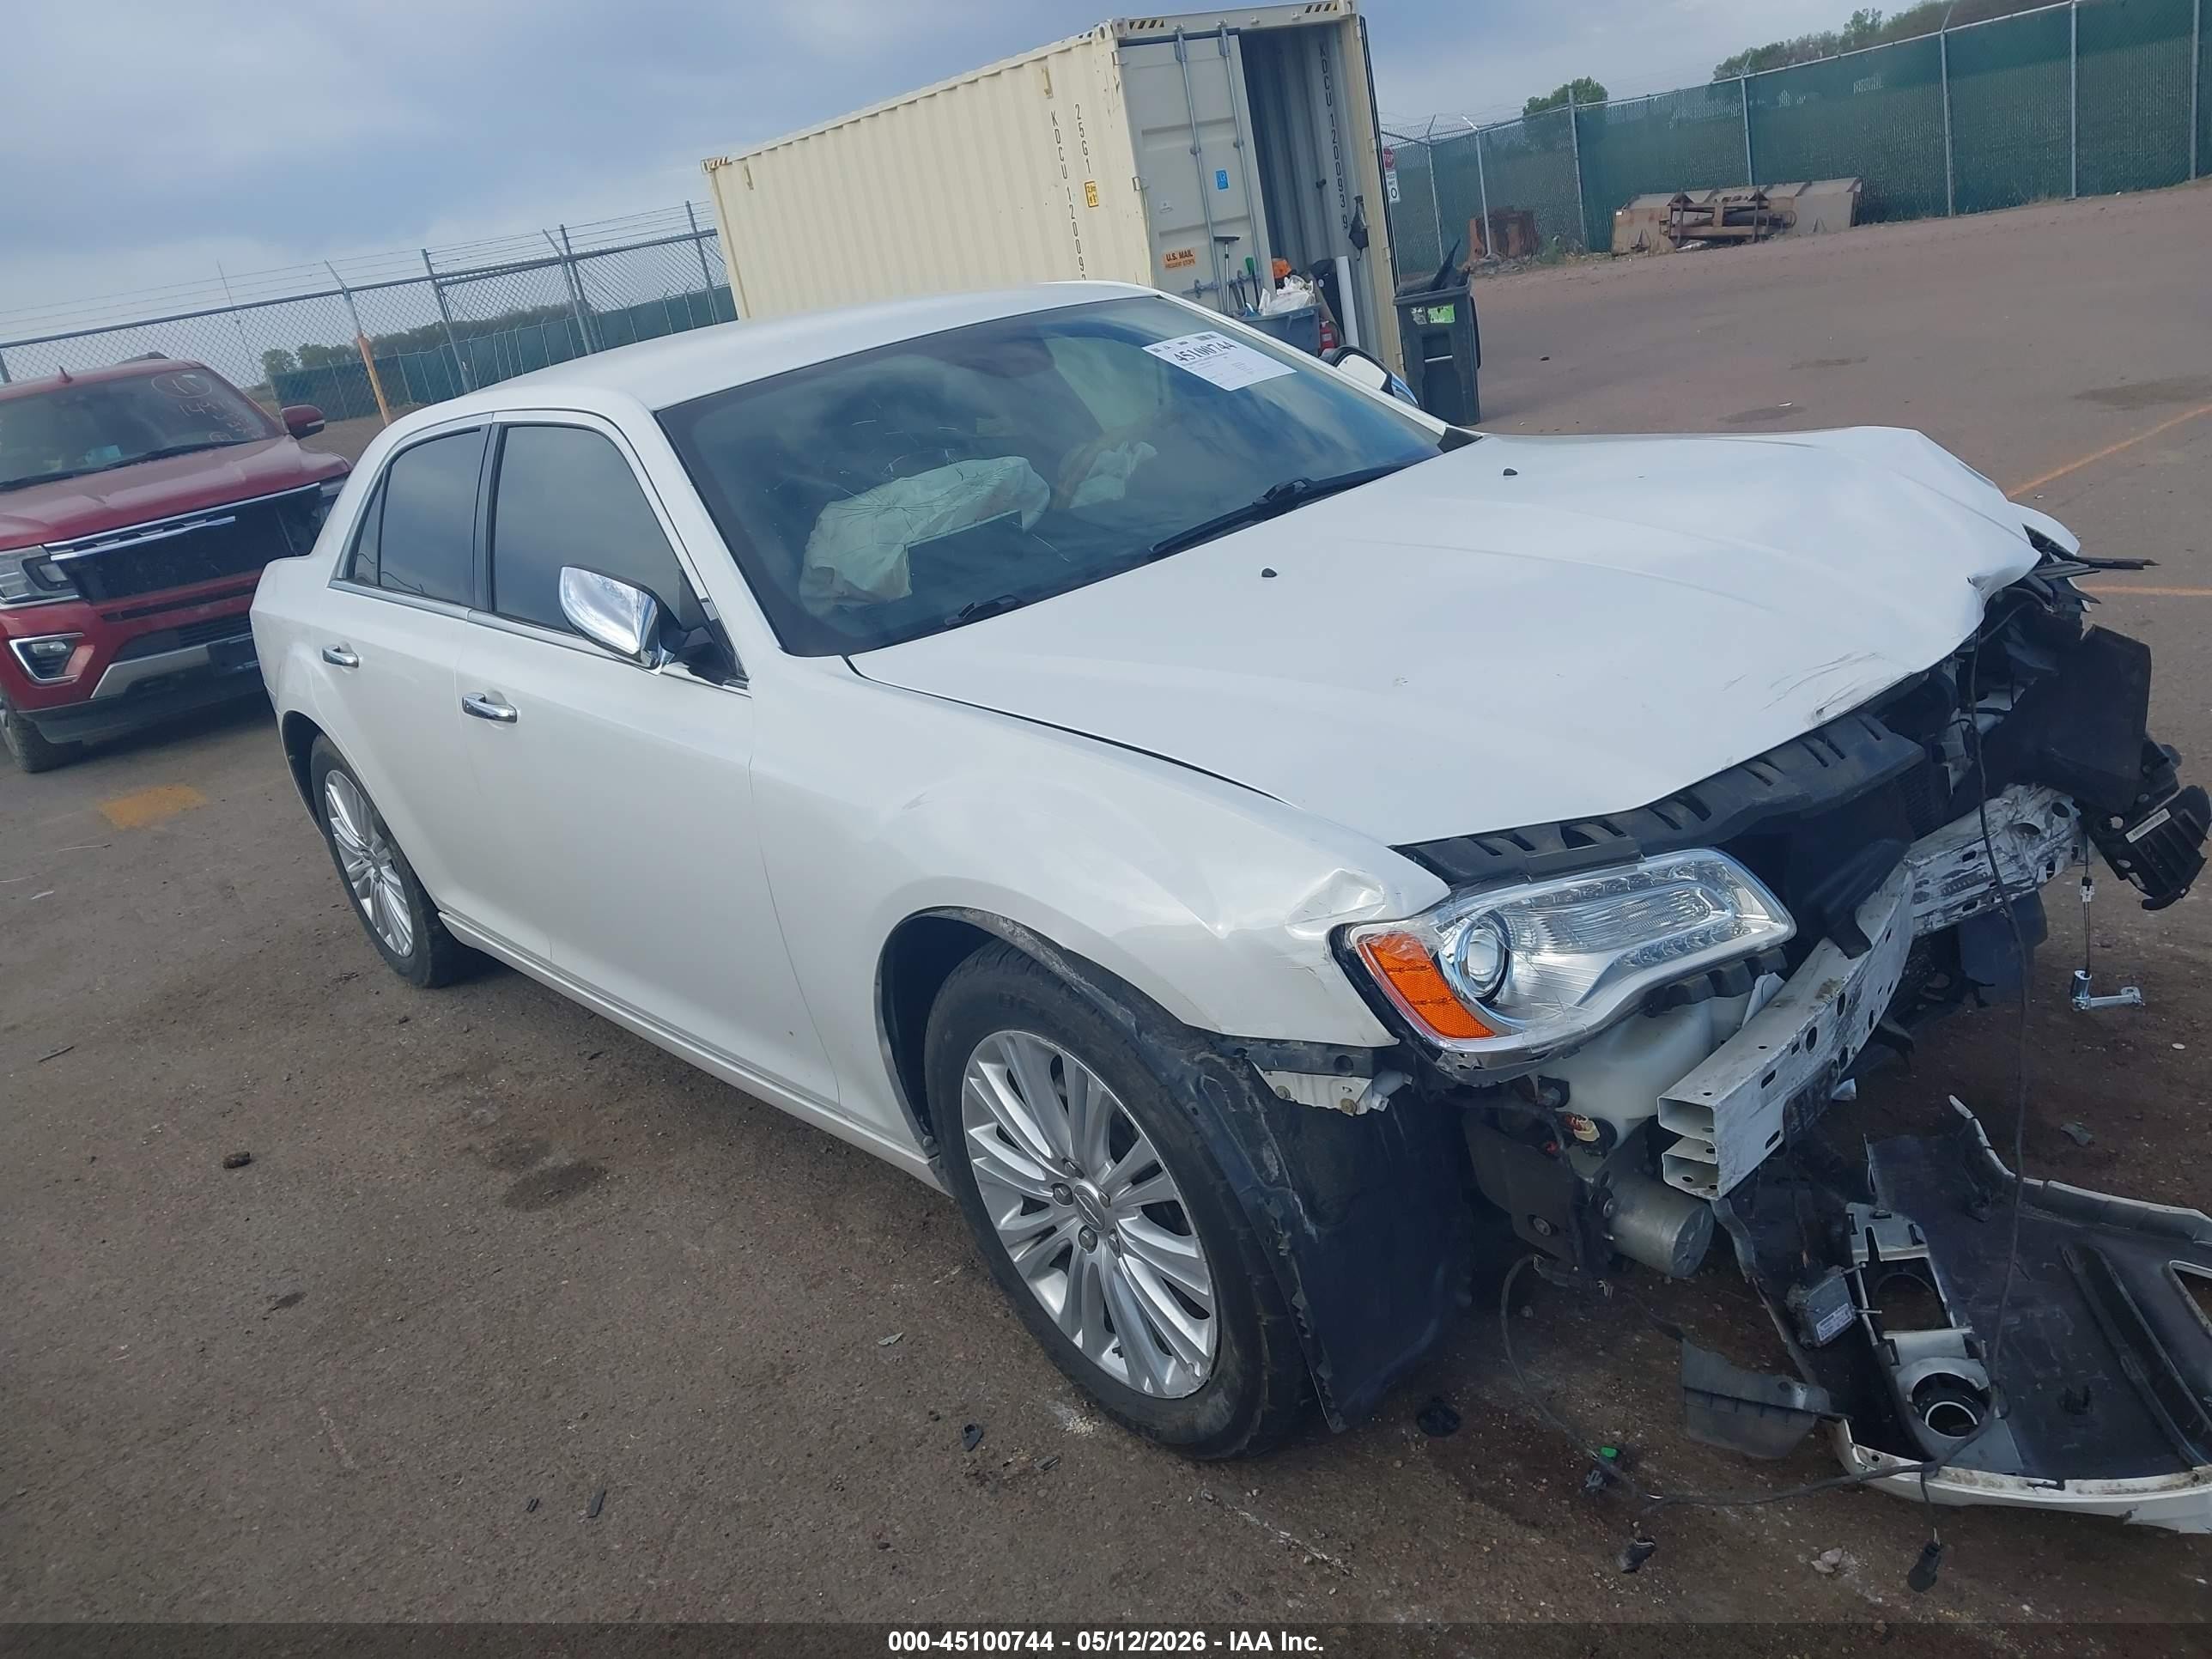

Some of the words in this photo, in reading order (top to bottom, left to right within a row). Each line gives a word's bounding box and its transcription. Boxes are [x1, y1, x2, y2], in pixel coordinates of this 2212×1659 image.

[1050, 110, 1068, 179] KDCU
[1074, 103, 1091, 173] 25G1
[1319, 42, 1332, 106] KDCU
[1330, 113, 1345, 208] 120093
[1165, 252, 1177, 261] U.S.
[1178, 249, 1194, 258] MAIL
[1173, 341, 1237, 362] 45100744
